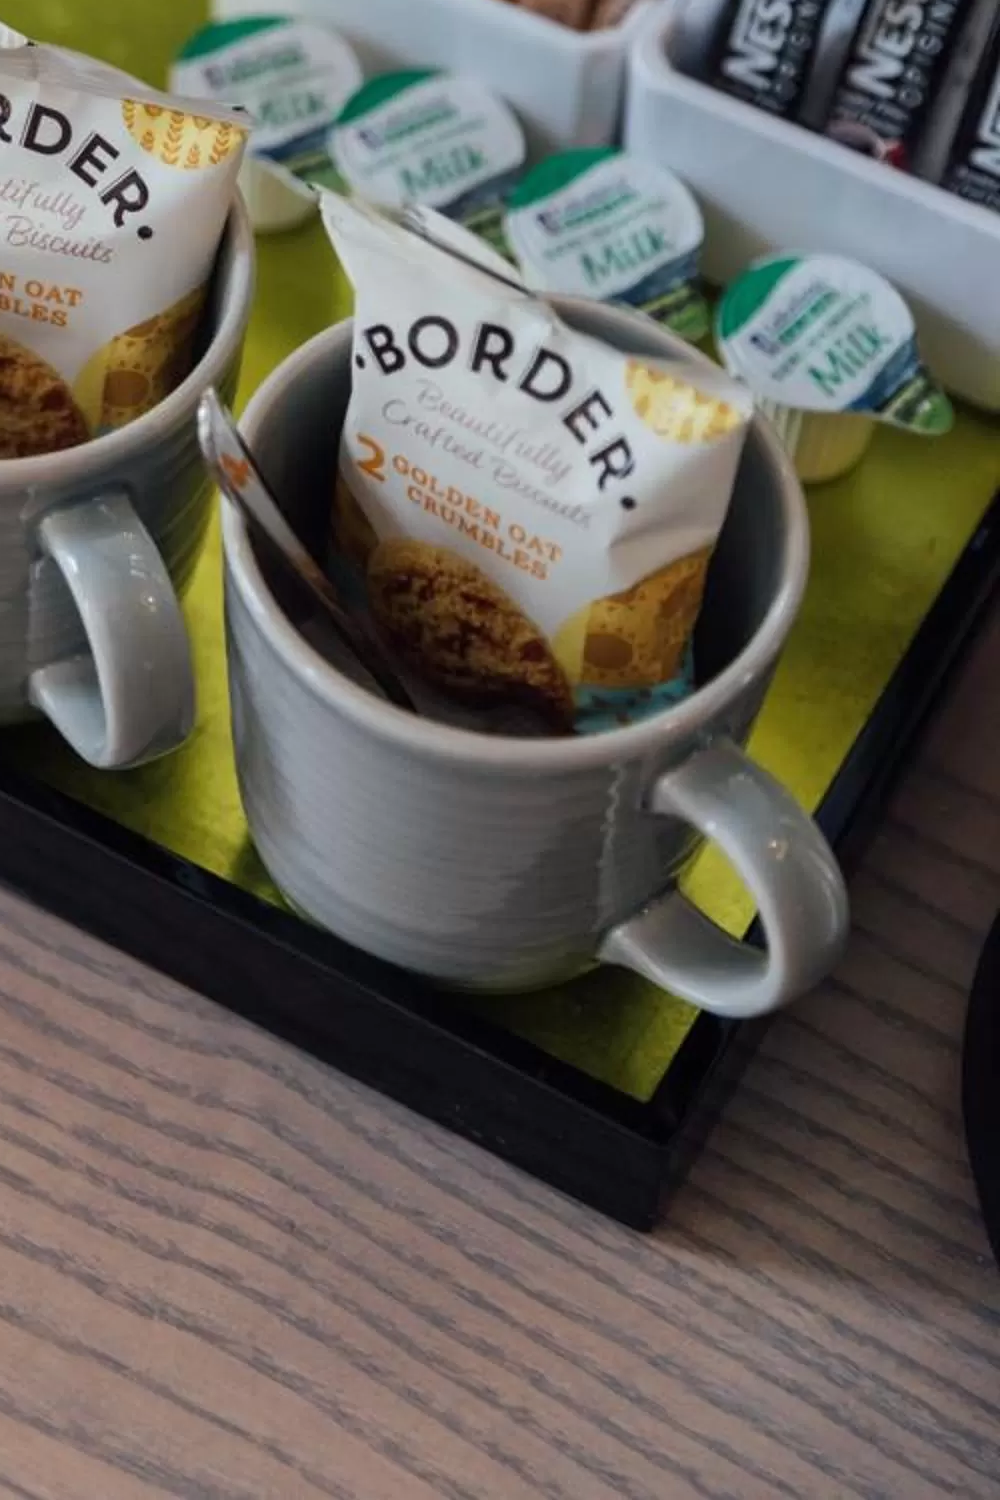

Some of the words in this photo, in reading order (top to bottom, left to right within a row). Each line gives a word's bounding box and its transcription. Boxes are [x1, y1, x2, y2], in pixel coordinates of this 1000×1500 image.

[6, 215, 114, 264] Biscuits
[578, 224, 672, 286] Milk
[24, 279, 84, 308] OAT
[807, 323, 892, 397] Milk
[364, 315, 636, 493] BORDER
[381, 399, 486, 470] Crafted
[415, 377, 574, 487] Beautifully
[355, 431, 387, 483] 2
[392, 453, 501, 530] GOLDEN
[508, 522, 563, 563] OAT
[406, 485, 549, 581] CRUMBLES
